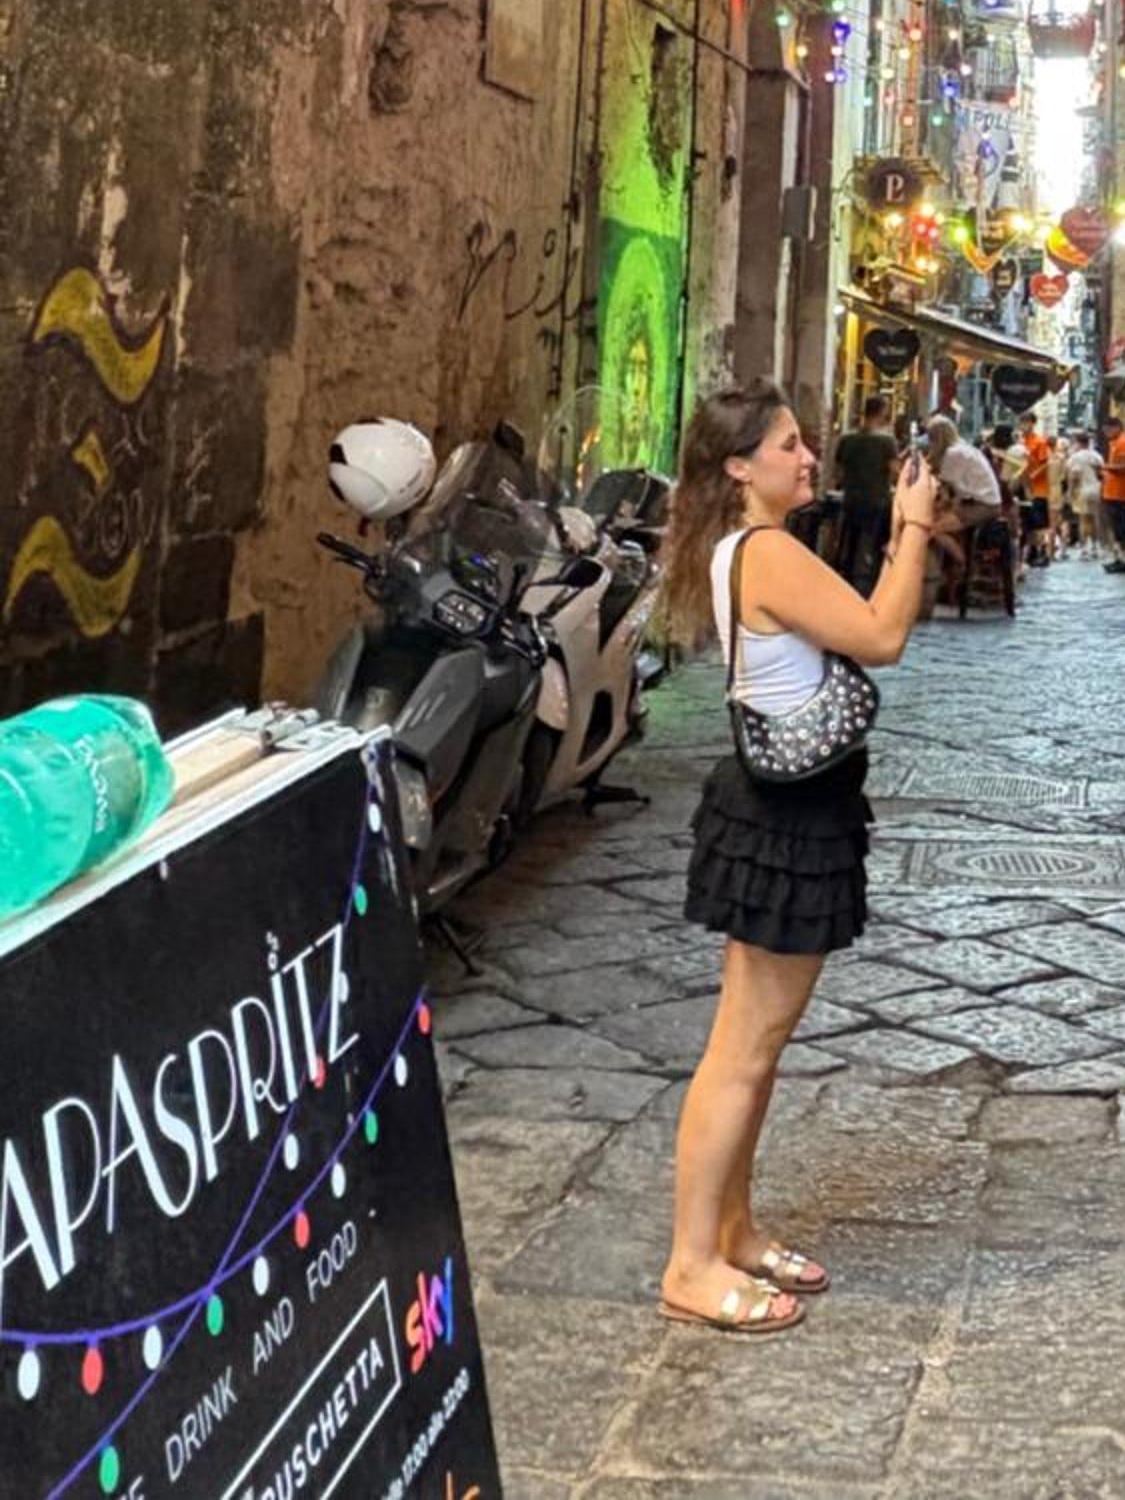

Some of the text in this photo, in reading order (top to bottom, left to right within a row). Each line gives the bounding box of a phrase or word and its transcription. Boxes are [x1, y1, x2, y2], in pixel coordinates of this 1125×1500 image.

[165, 1220, 358, 1483] DRINK AND FOOD
[405, 1256, 454, 1374] sky
